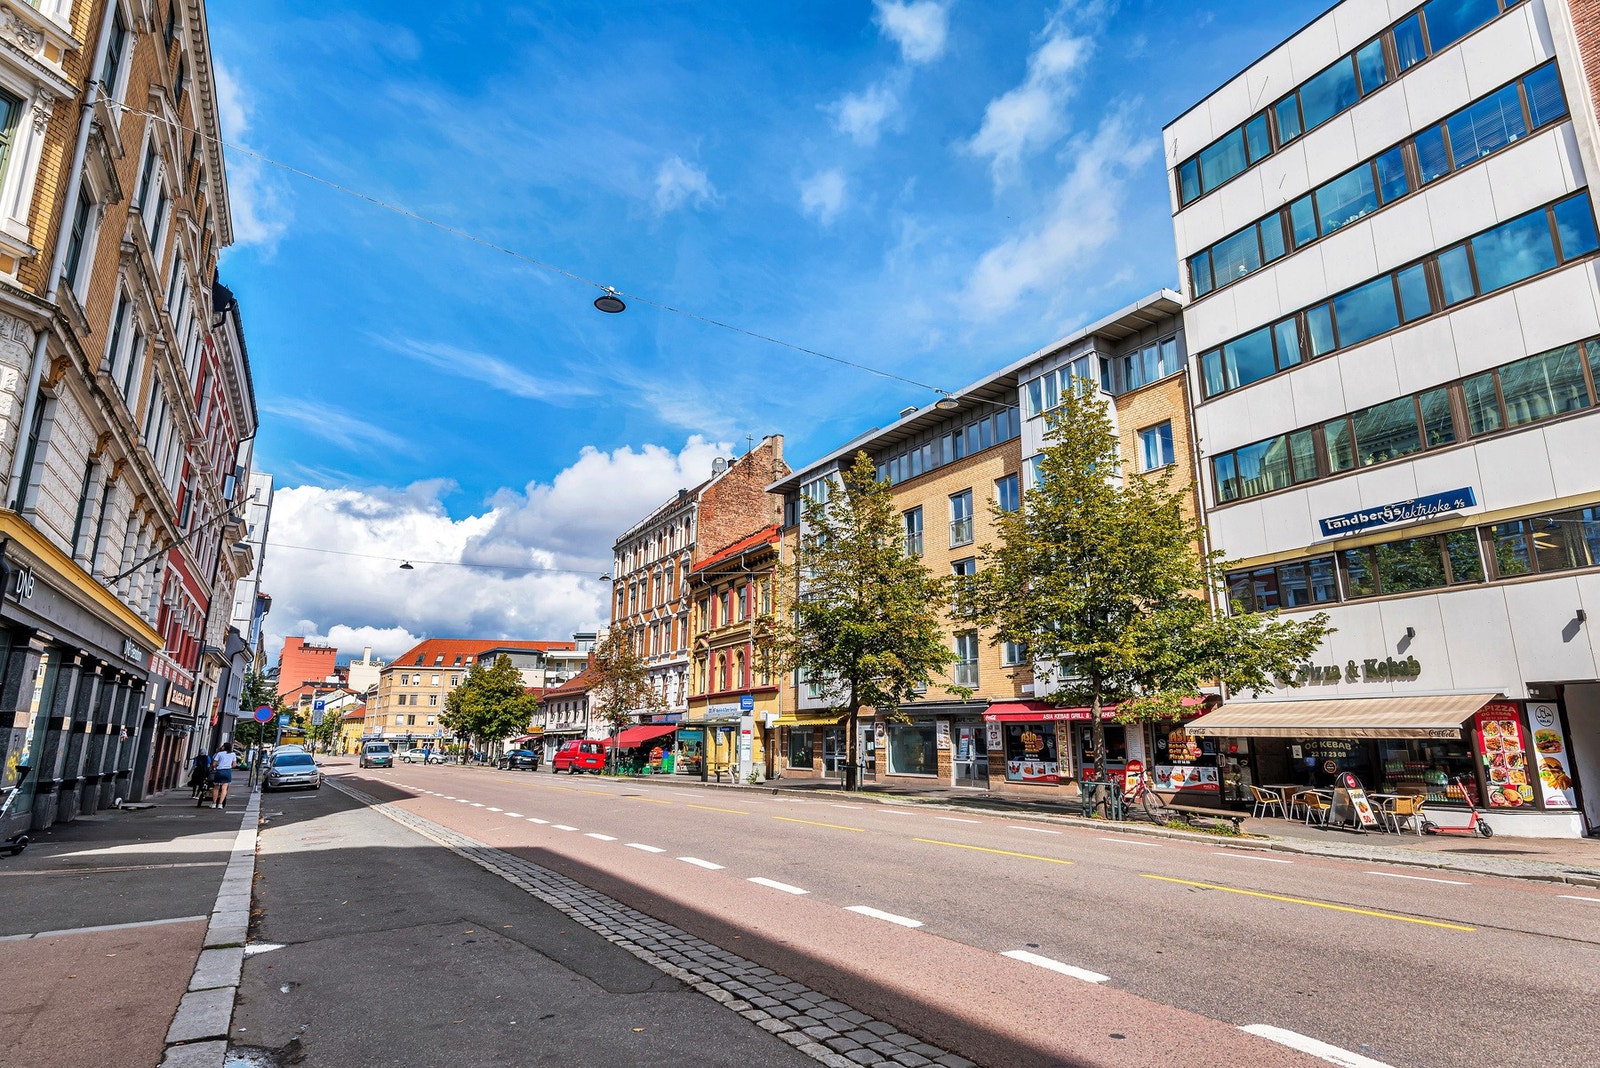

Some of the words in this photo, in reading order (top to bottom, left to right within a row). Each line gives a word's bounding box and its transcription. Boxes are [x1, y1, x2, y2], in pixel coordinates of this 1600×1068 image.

[16, 566, 35, 603] DNB
[1345, 660, 1361, 679] &
[1363, 655, 1421, 679] Kebab
[1320, 741, 1352, 750] KEBAB
